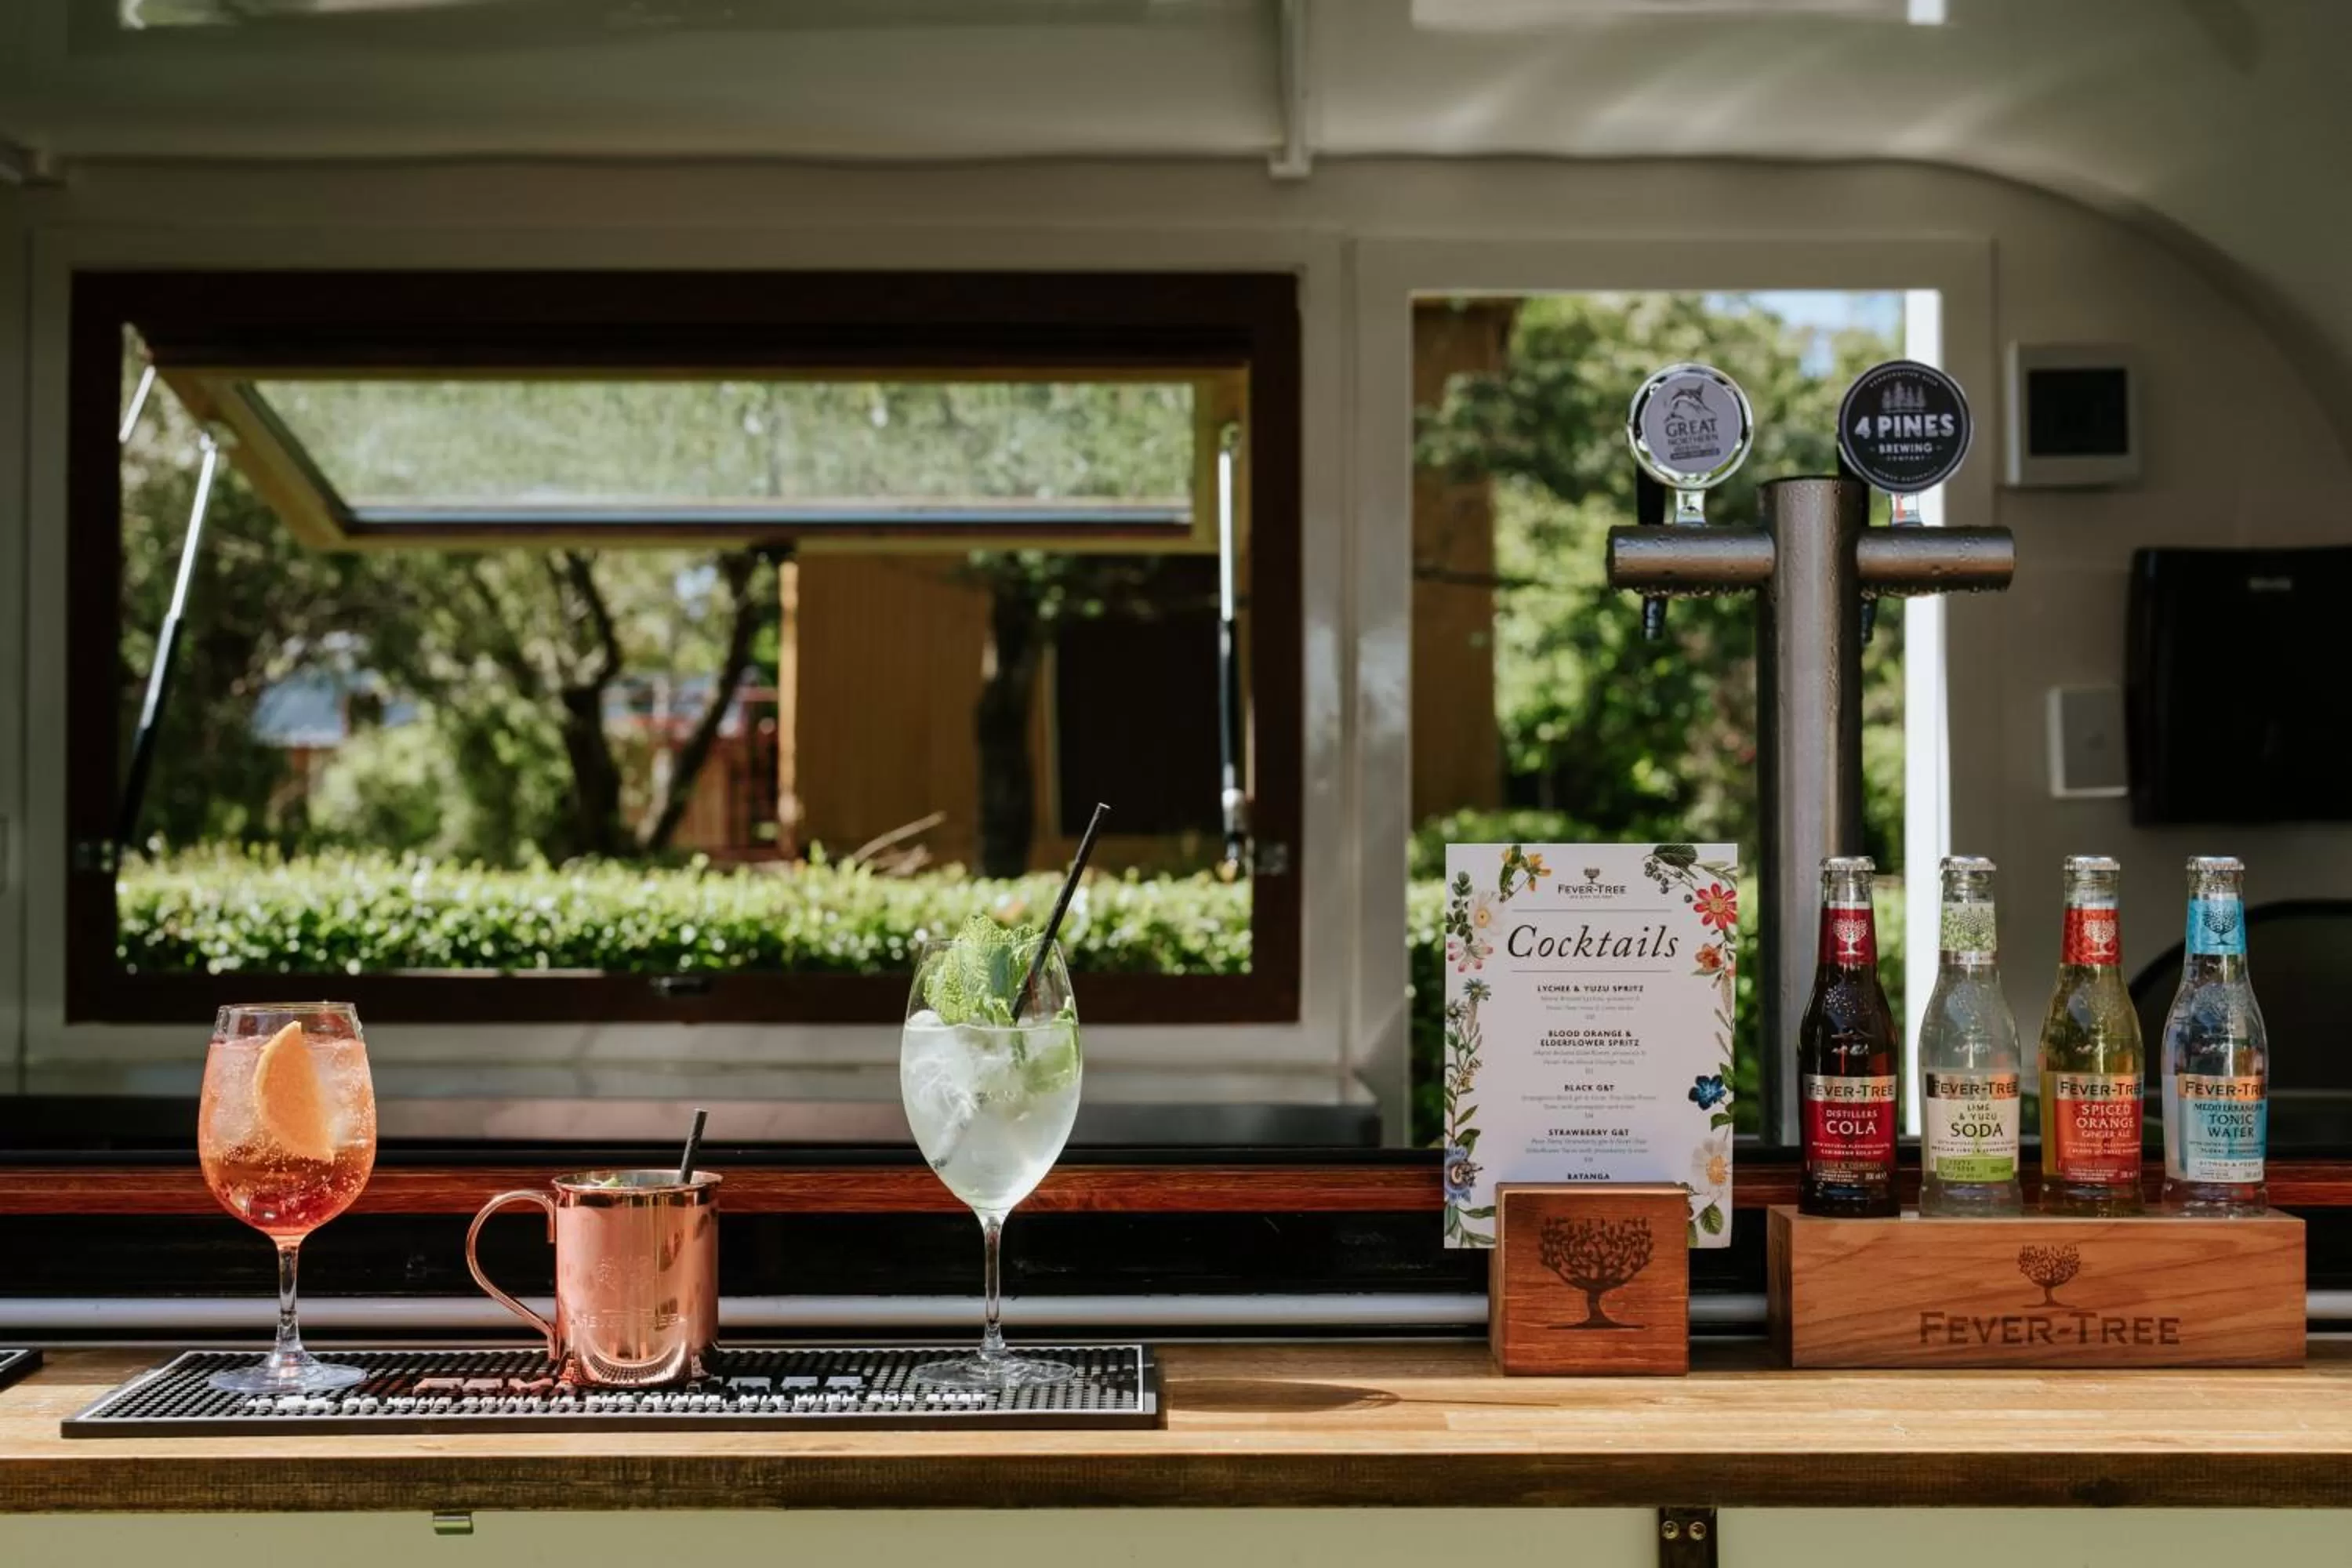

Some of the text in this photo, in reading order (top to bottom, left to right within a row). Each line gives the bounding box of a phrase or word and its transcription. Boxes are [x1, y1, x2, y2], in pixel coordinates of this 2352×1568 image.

[1665, 418, 1718, 437] GREAT
[1855, 413, 1955, 439] 4 PINES
[1878, 442, 1933, 454] BREWING
[1508, 924, 1679, 959] Cocktails
[1809, 1083, 1894, 1097] FEVER-TREE
[2060, 1080, 2143, 1096] FEVER-TRE
[1826, 1109, 1878, 1118] DISTILLERS
[2082, 1104, 2131, 1116] SPICED
[2076, 1117, 2135, 1128] ORANGE
[2209, 1114, 2253, 1124] TONIC
[1826, 1120, 1877, 1134] COLA
[1950, 1123, 2003, 1137] SODA
[2082, 1130, 2114, 1138] GINGER
[2207, 1127, 2255, 1138] WATER
[1919, 1311, 2181, 1345] FEVER-TREE
